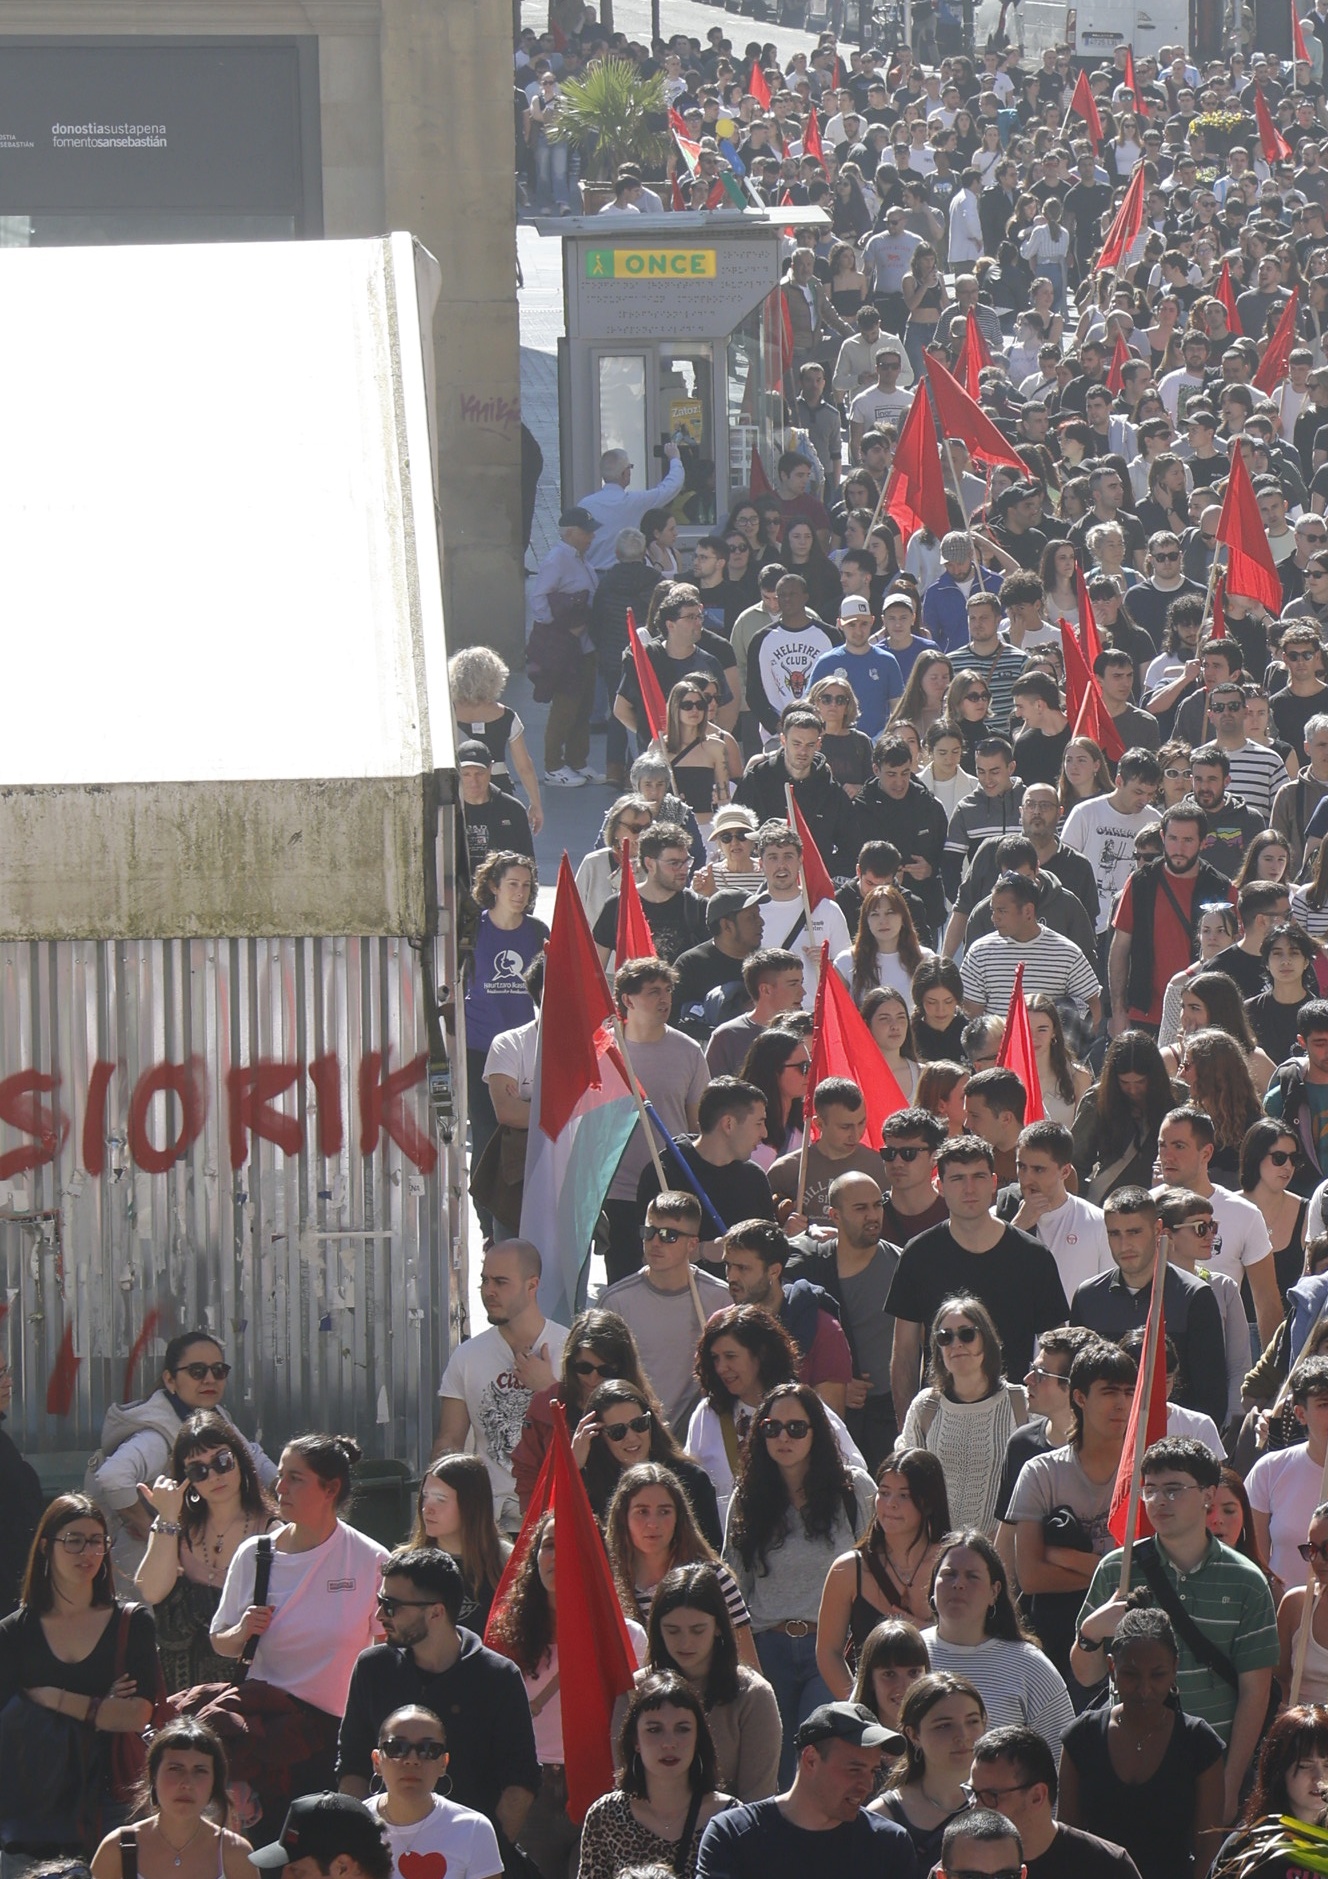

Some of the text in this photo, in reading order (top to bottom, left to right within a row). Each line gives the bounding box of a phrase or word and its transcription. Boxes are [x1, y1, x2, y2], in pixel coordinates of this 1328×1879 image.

[52, 122, 166, 136] donostiasustapena
[53, 135, 167, 148] fomentosansebastián
[625, 254, 706, 275] ONCE
[671, 404, 702, 418] Zatoz!
[773, 643, 820, 660] HELLFIRE
[786, 656, 808, 665] CLUB
